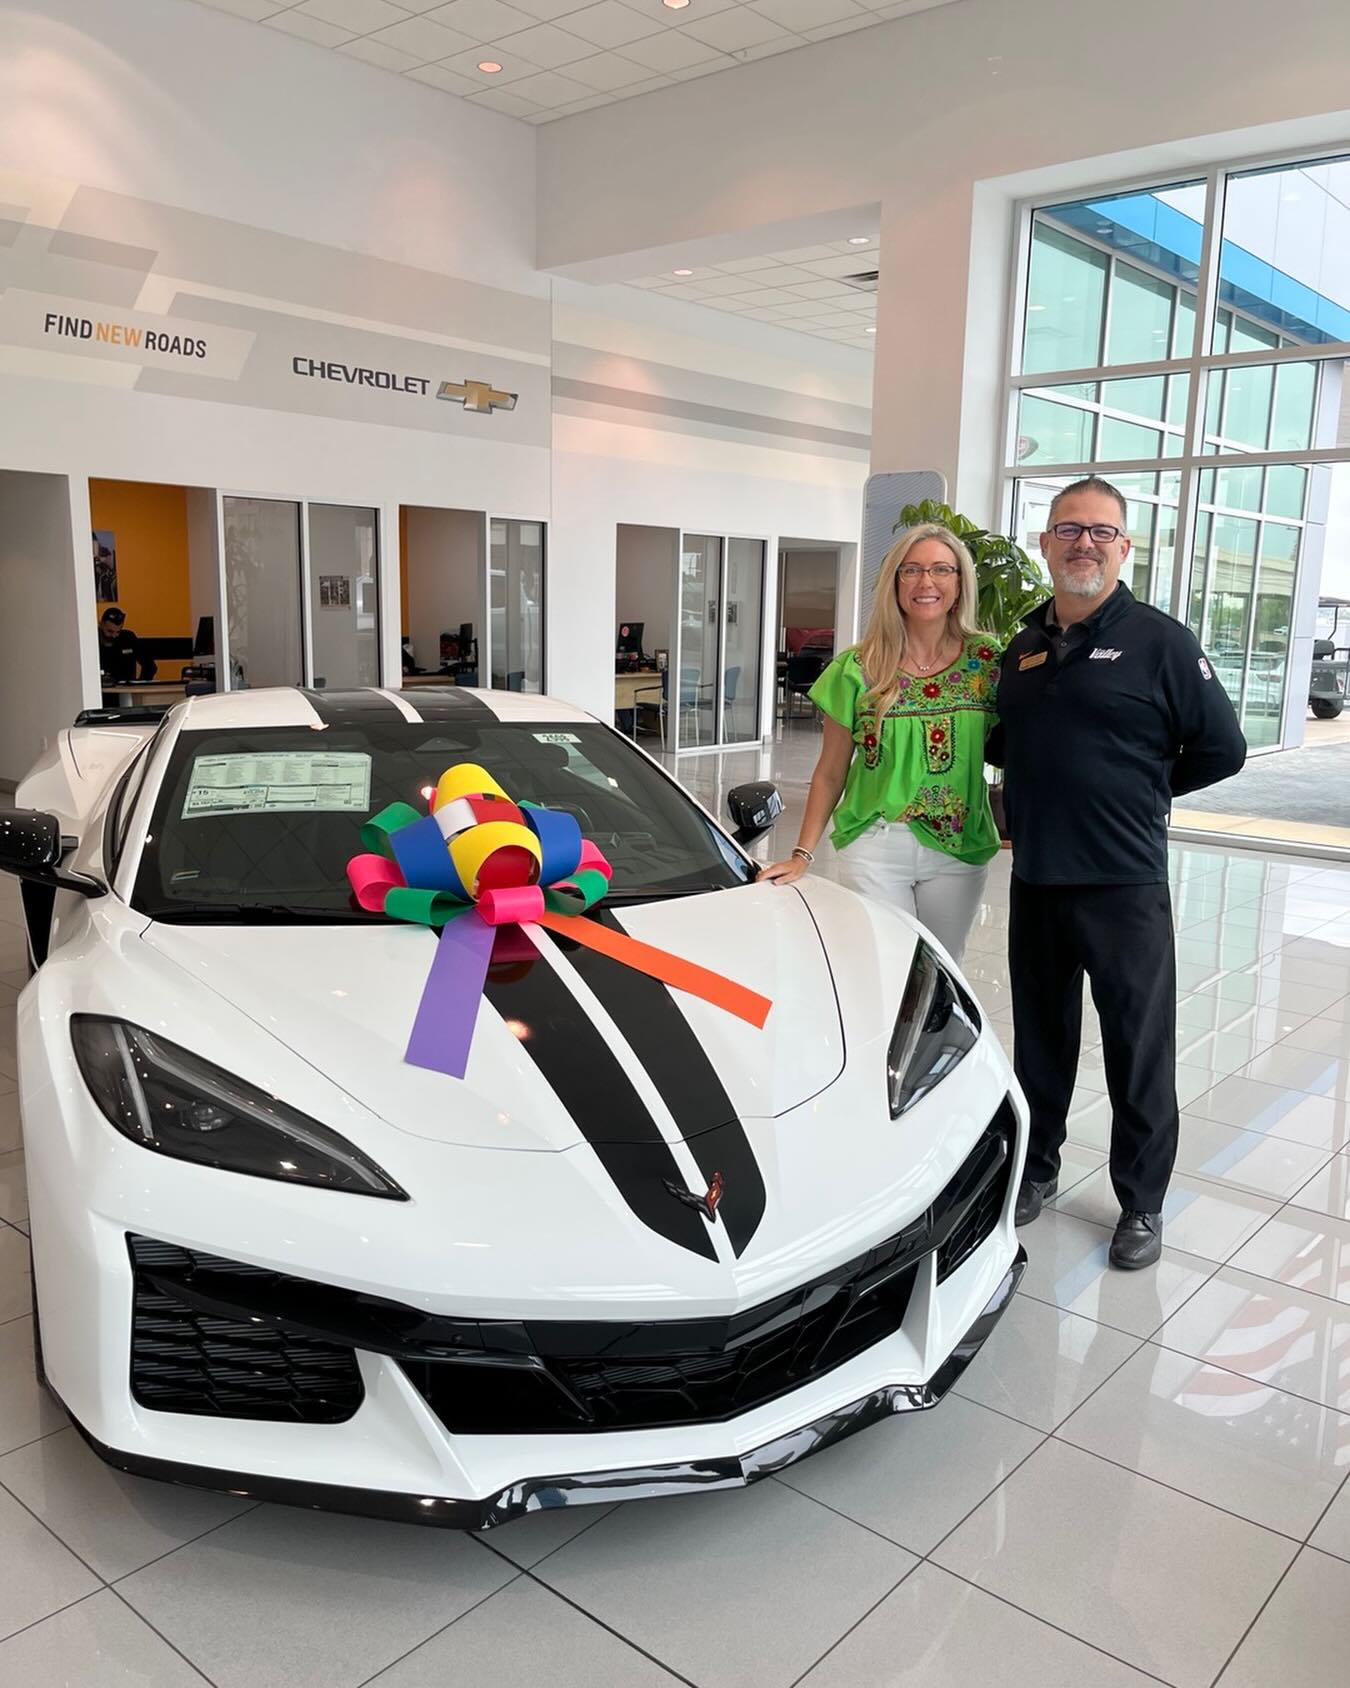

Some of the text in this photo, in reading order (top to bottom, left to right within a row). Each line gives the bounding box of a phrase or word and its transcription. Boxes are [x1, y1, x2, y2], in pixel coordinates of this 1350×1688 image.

[44, 313, 207, 359] FIND NEW ROADS
[292, 356, 431, 396] CHEVROLET
